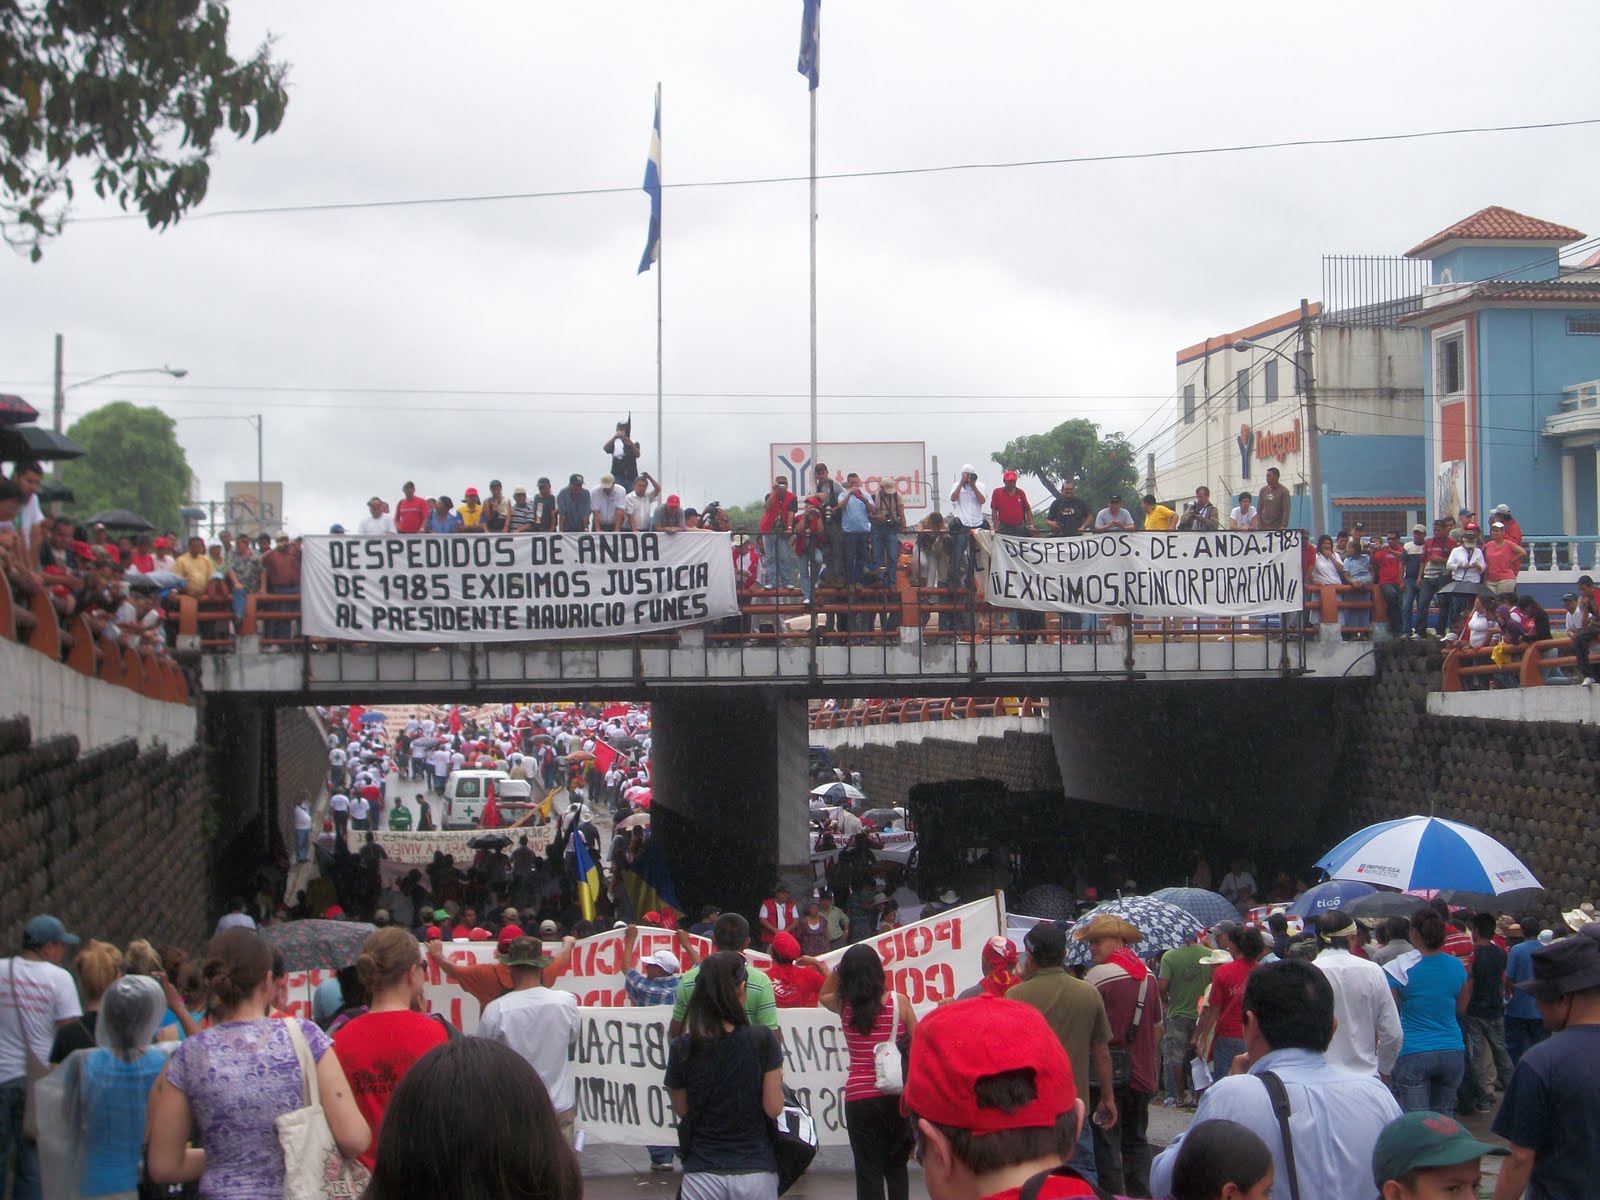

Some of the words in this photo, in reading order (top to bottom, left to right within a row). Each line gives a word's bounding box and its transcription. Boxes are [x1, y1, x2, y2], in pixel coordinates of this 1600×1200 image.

[1255, 418, 1301, 463] Integral
[329, 537, 515, 569] DESPEDIDOS
[532, 535, 564, 566] DE
[333, 574, 366, 600] DE
[378, 574, 450, 601] 1985
[461, 571, 591, 600] EXIGIMOS
[601, 562, 709, 596] JUSTICIA
[335, 603, 363, 630] AL
[371, 605, 518, 631] PRESIDENTE
[526, 601, 625, 629] MAURICIO
[633, 593, 709, 625] FUNES
[1366, 864, 1400, 873] IMPRESSA
